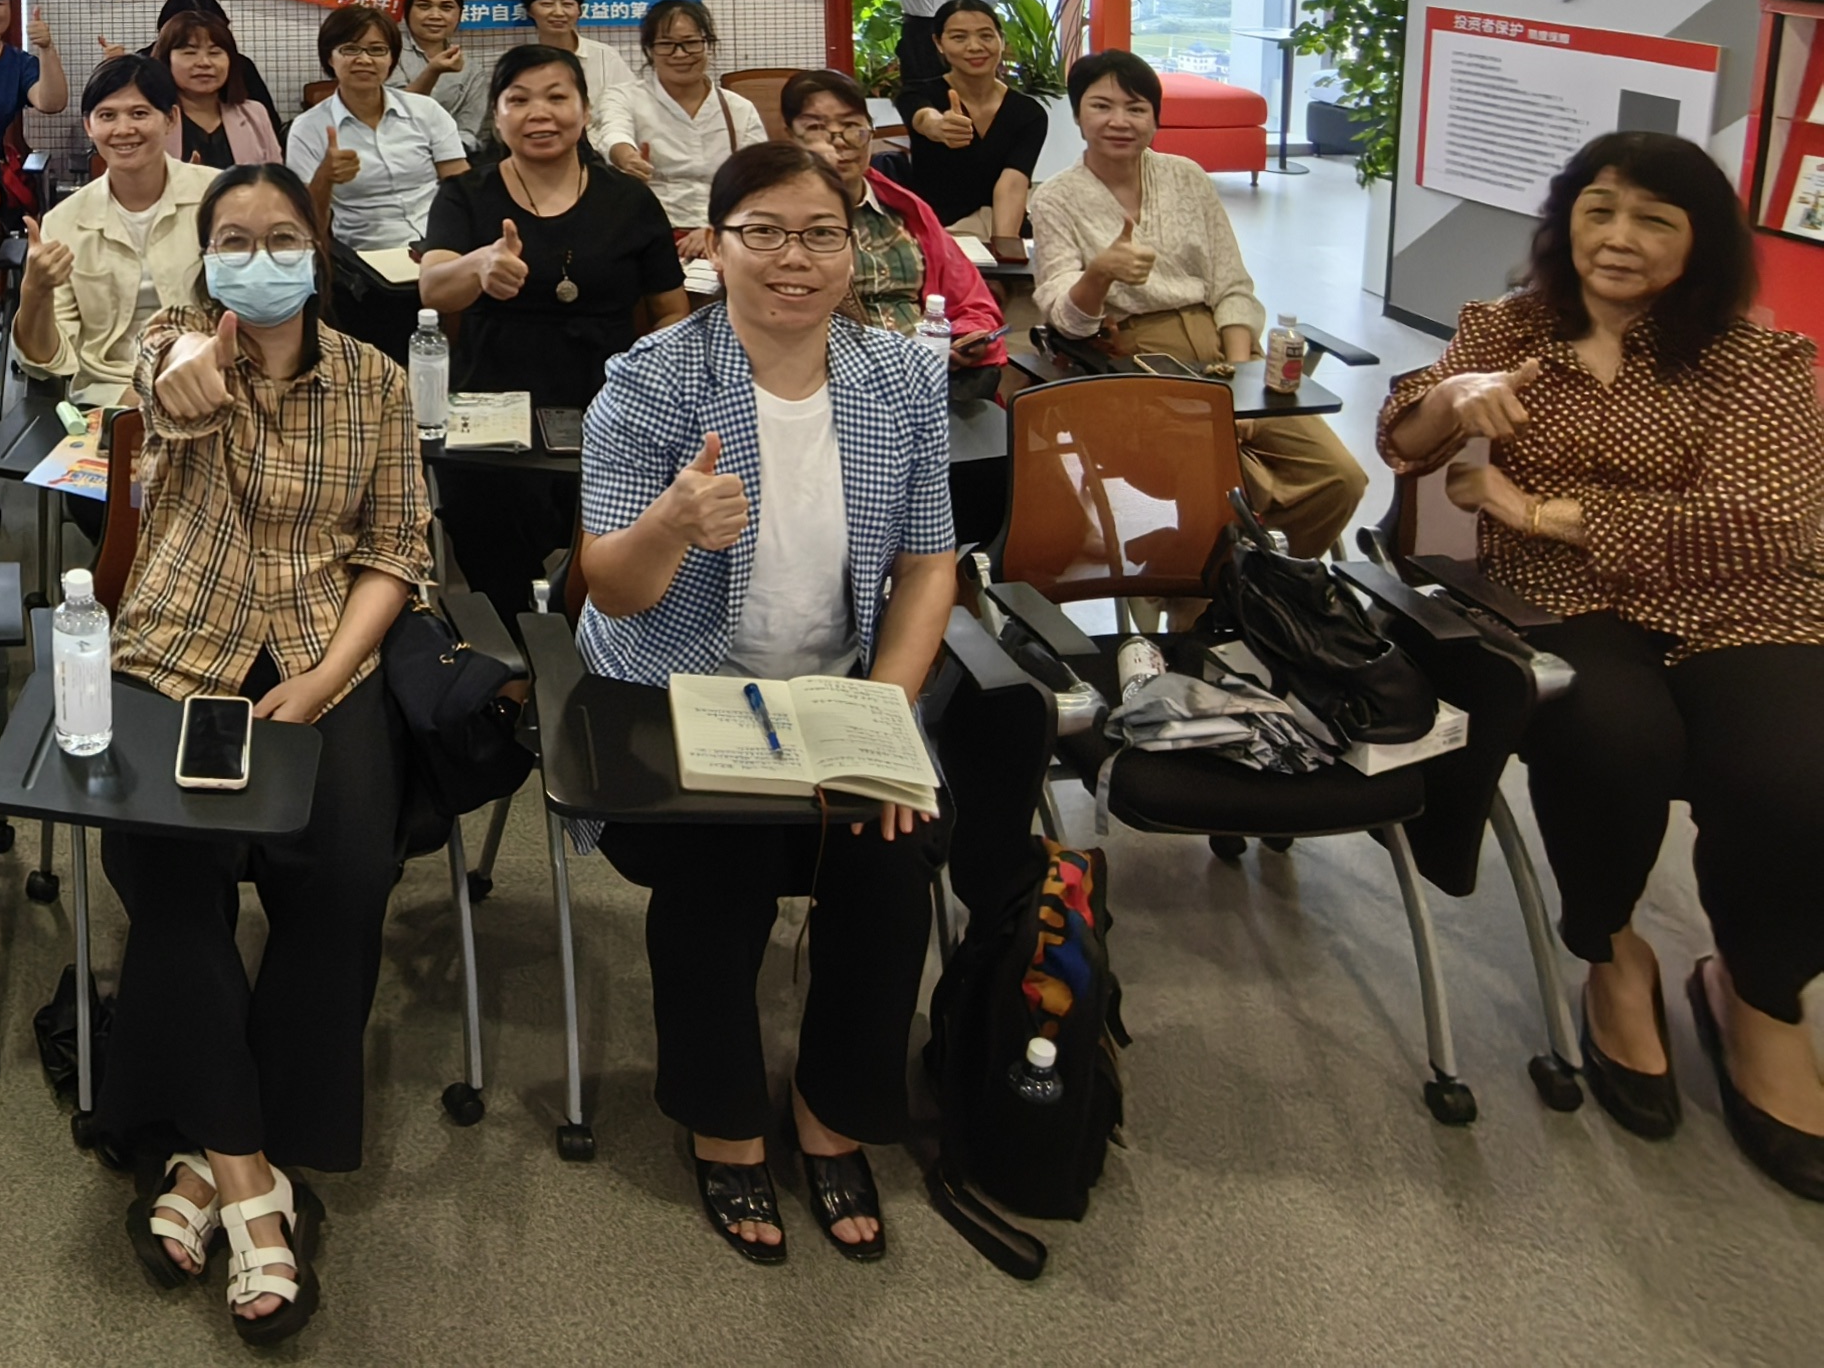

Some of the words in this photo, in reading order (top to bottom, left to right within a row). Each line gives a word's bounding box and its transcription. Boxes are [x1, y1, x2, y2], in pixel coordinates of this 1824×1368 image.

[1453, 14, 1525, 38] 投资者保护
